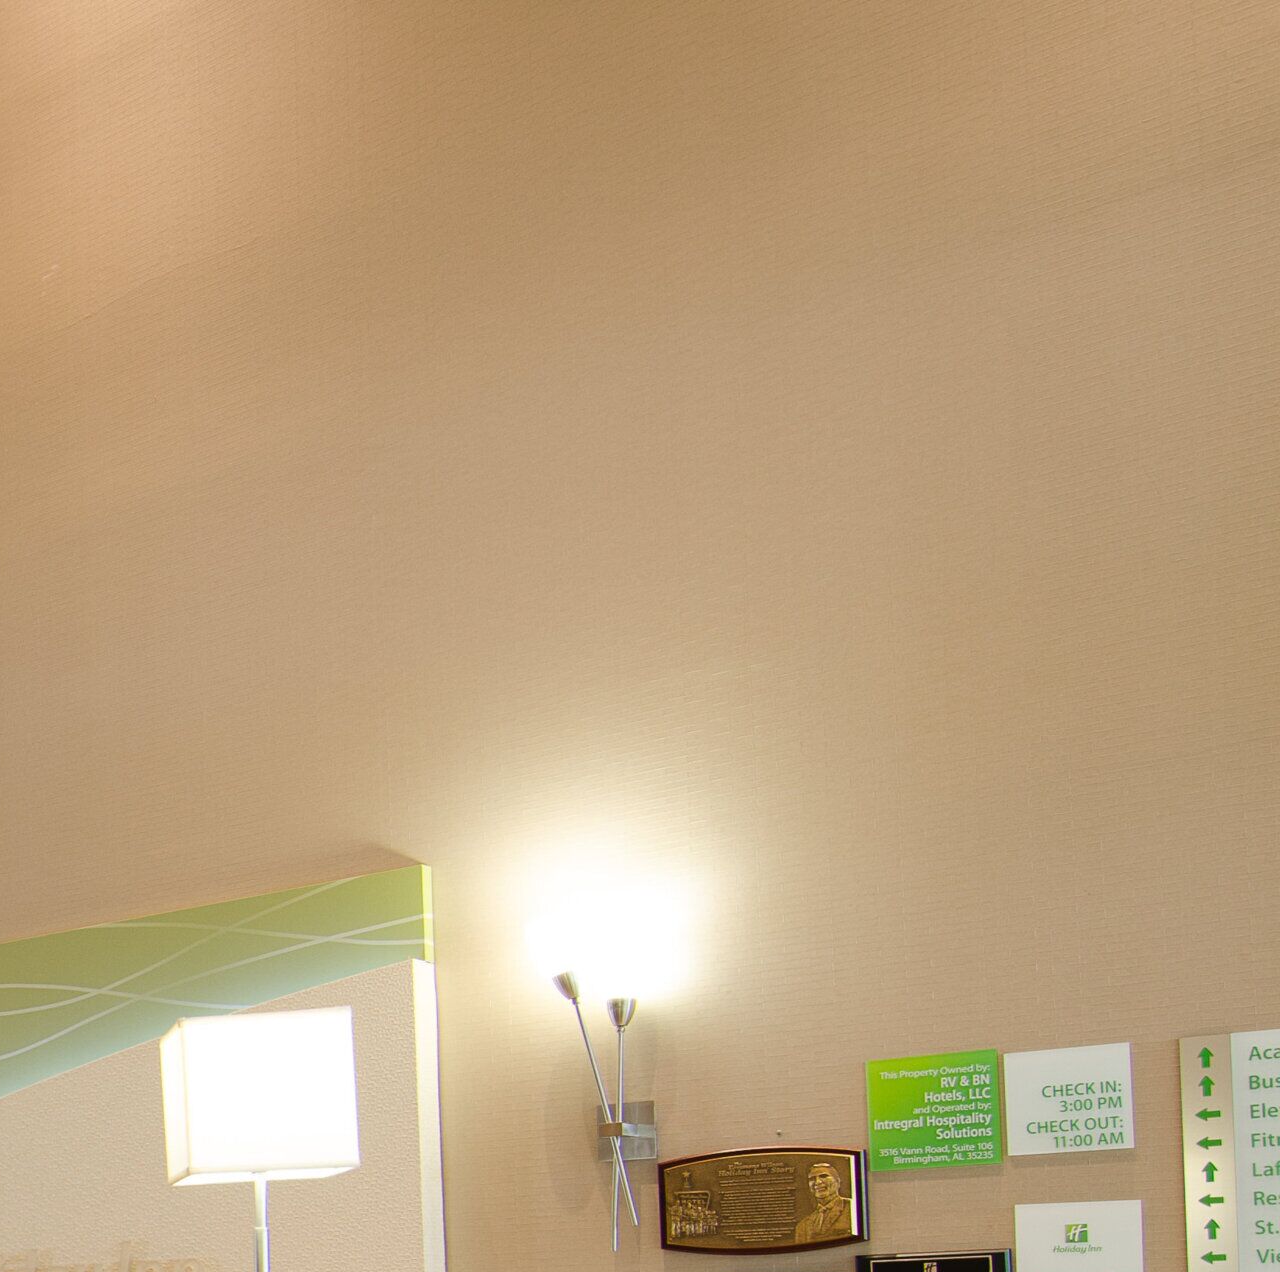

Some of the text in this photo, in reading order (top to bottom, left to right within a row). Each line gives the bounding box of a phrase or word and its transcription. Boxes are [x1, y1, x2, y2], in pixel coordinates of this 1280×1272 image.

[880, 1063, 991, 1080] This Property Owned by:
[940, 1074, 990, 1088] RV & BN
[924, 1087, 991, 1103] Hotels, LLC
[1041, 1080, 1122, 1098] CHECK IN:
[912, 1101, 992, 1114] and Operated by:
[1060, 1096, 1123, 1112] 3:00 PM
[874, 1112, 992, 1131] Intregral Hospitality
[1026, 1116, 1124, 1134] CHECK OUT:
[936, 1126, 993, 1140] Solutions
[1053, 1132, 1124, 1148] 11:00 AM
[879, 1147, 898, 1157] 3516
[900, 1146, 923, 1156] Vann
[952, 1142, 975, 1152] Suite
[978, 1142, 993, 1151] 106
[893, 1150, 994, 1165] Birmingham, AL 35235
[718, 1169, 751, 1177] Holiday
[771, 1166, 795, 1174] Story
[1255, 1220, 1280, 1235] St.
[1053, 1244, 1103, 1254] Holiday Inn
